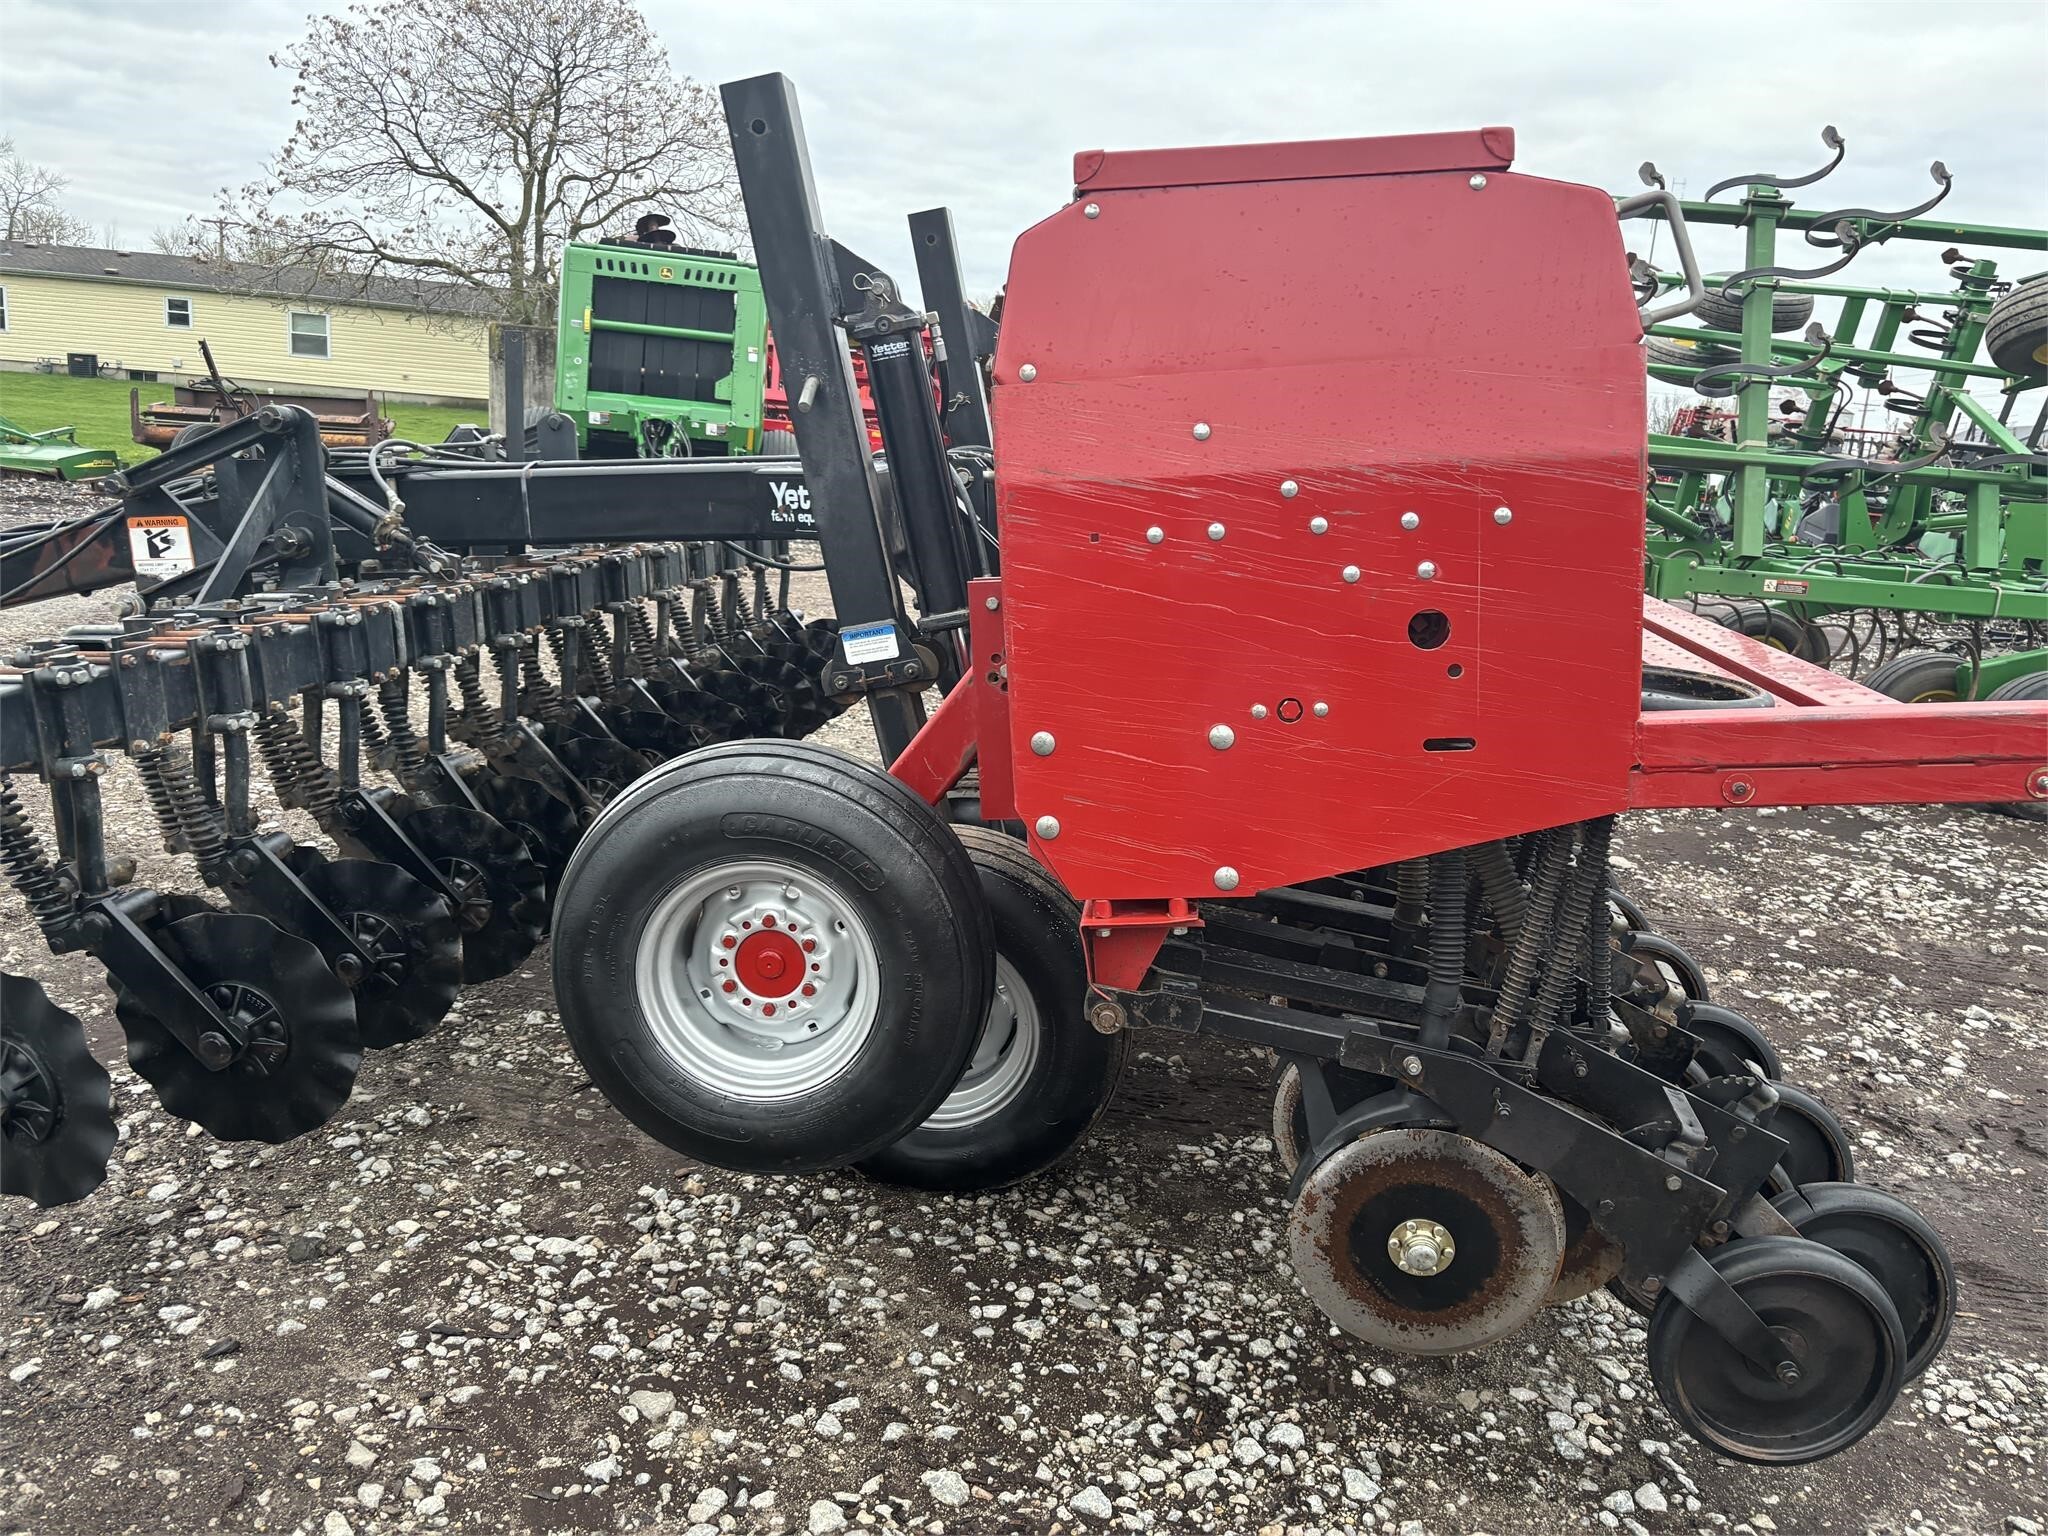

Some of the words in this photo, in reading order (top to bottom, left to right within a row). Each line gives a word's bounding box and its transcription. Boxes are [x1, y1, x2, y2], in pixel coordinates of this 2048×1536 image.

[870, 341, 910, 354] Yetter
[144, 518, 179, 527] WARNING
[849, 628, 885, 640] IMPORTANT
[741, 814, 877, 883] CARLISLE
